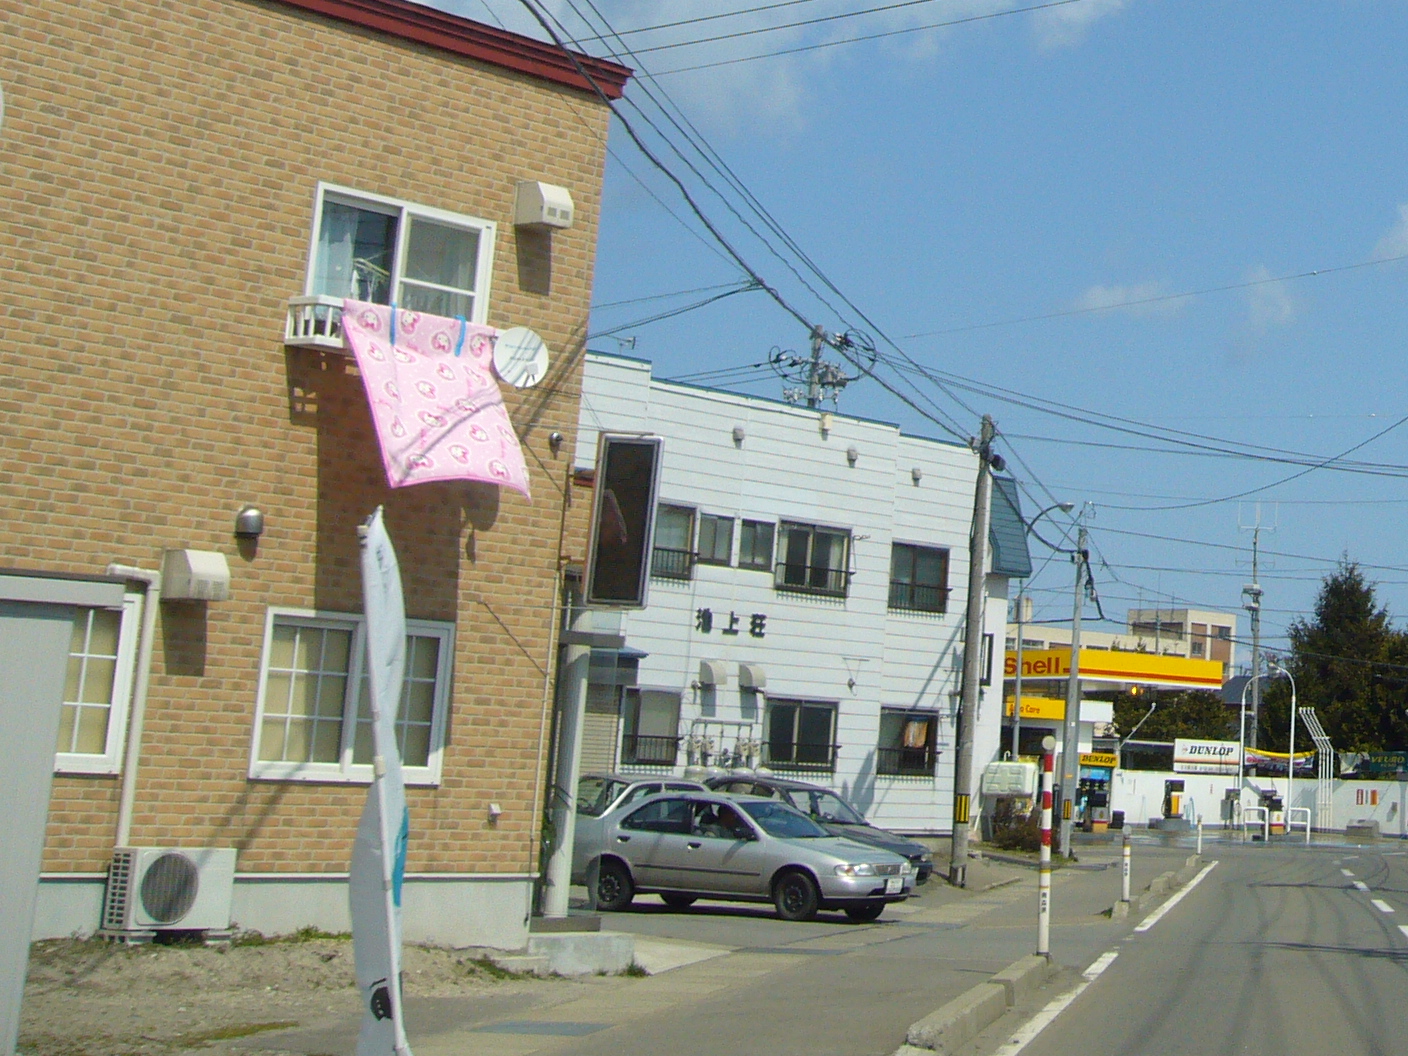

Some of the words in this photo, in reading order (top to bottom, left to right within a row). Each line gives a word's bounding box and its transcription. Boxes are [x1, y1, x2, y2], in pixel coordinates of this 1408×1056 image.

[1004, 657, 1060, 674] Shell
[1189, 745, 1234, 756] DUNLOP
[1081, 754, 1117, 764] DUNLOP
